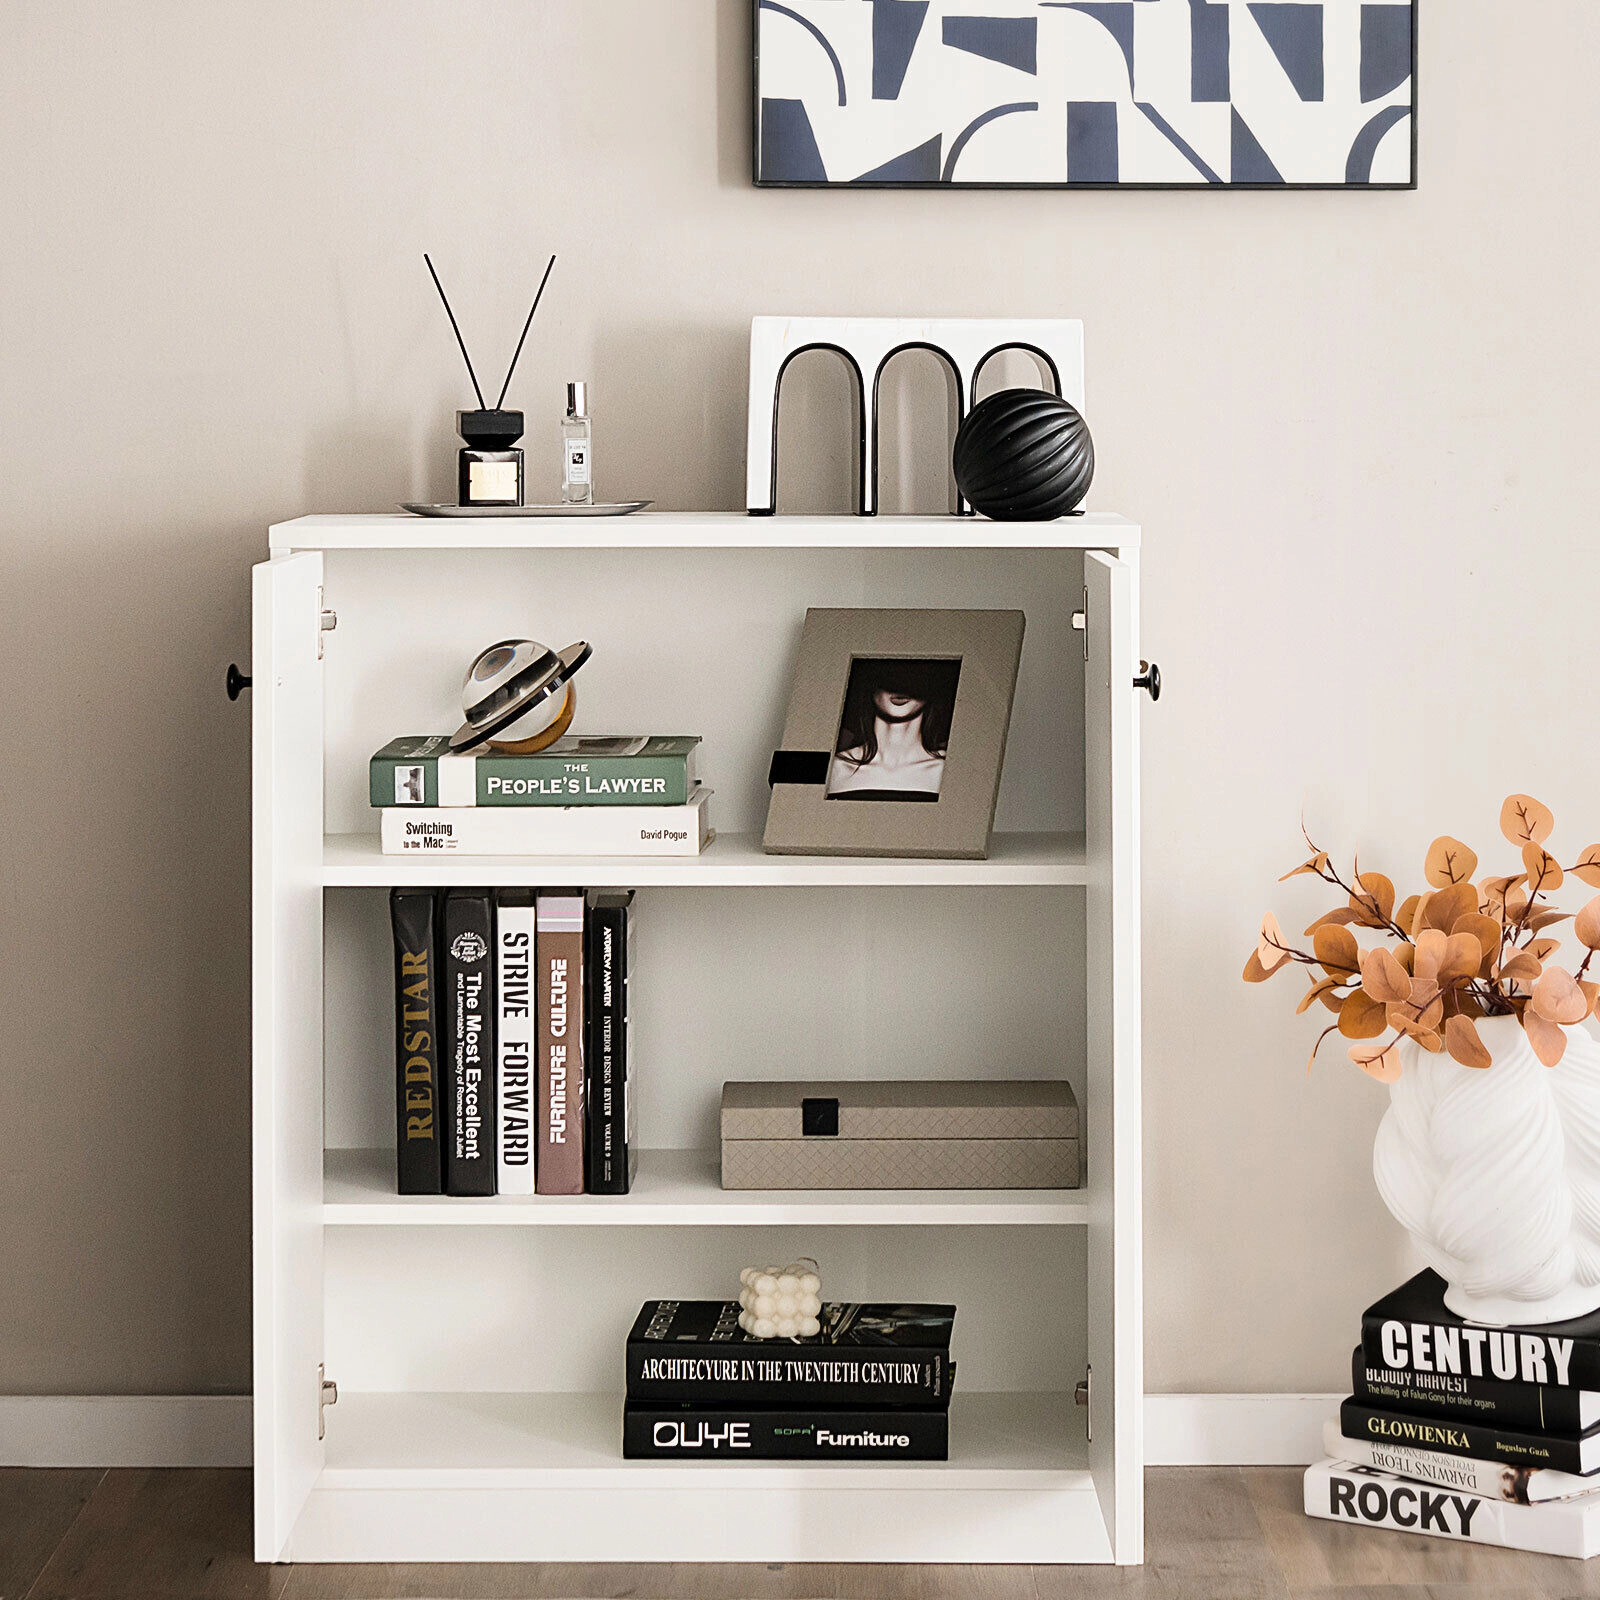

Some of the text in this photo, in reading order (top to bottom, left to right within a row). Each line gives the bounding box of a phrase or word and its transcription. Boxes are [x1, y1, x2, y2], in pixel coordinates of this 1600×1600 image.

[563, 763, 589, 772] THE
[585, 776, 666, 794] LAWYER
[405, 821, 453, 837] Switching
[423, 836, 444, 849] Mac
[640, 829, 687, 841] David Pogue
[603, 926, 612, 1007] ANDREW MARTIN
[465, 972, 482, 1009] The
[550, 959, 567, 1038] CULTURE
[465, 1014, 482, 1064] Most
[503, 932, 529, 1166] STRIVE FORWARD
[455, 973, 464, 1159] and Lamentable Tragedy of Romeo and Juliet
[603, 1016, 611, 1116] INTERIOR DESIGN REVIEW
[465, 1068, 482, 1160] Excellent
[604, 1123, 612, 1151] VOLUME
[1380, 1320, 1575, 1386] CENTURY
[641, 1358, 738, 1381] ARCHITECYURE
[741, 1360, 755, 1381] IN
[757, 1360, 783, 1382] THE
[785, 1361, 859, 1383] TWENTIETH
[861, 1362, 921, 1384] CENTURY
[1366, 1383, 1496, 1410] The killing of Falun Gong for their organs
[816, 1429, 910, 1447] Furniture
[1371, 1452, 1413, 1474] TEORI
[1415, 1461, 1478, 1490] DARWINS
[1329, 1476, 1482, 1537] ROCKY
